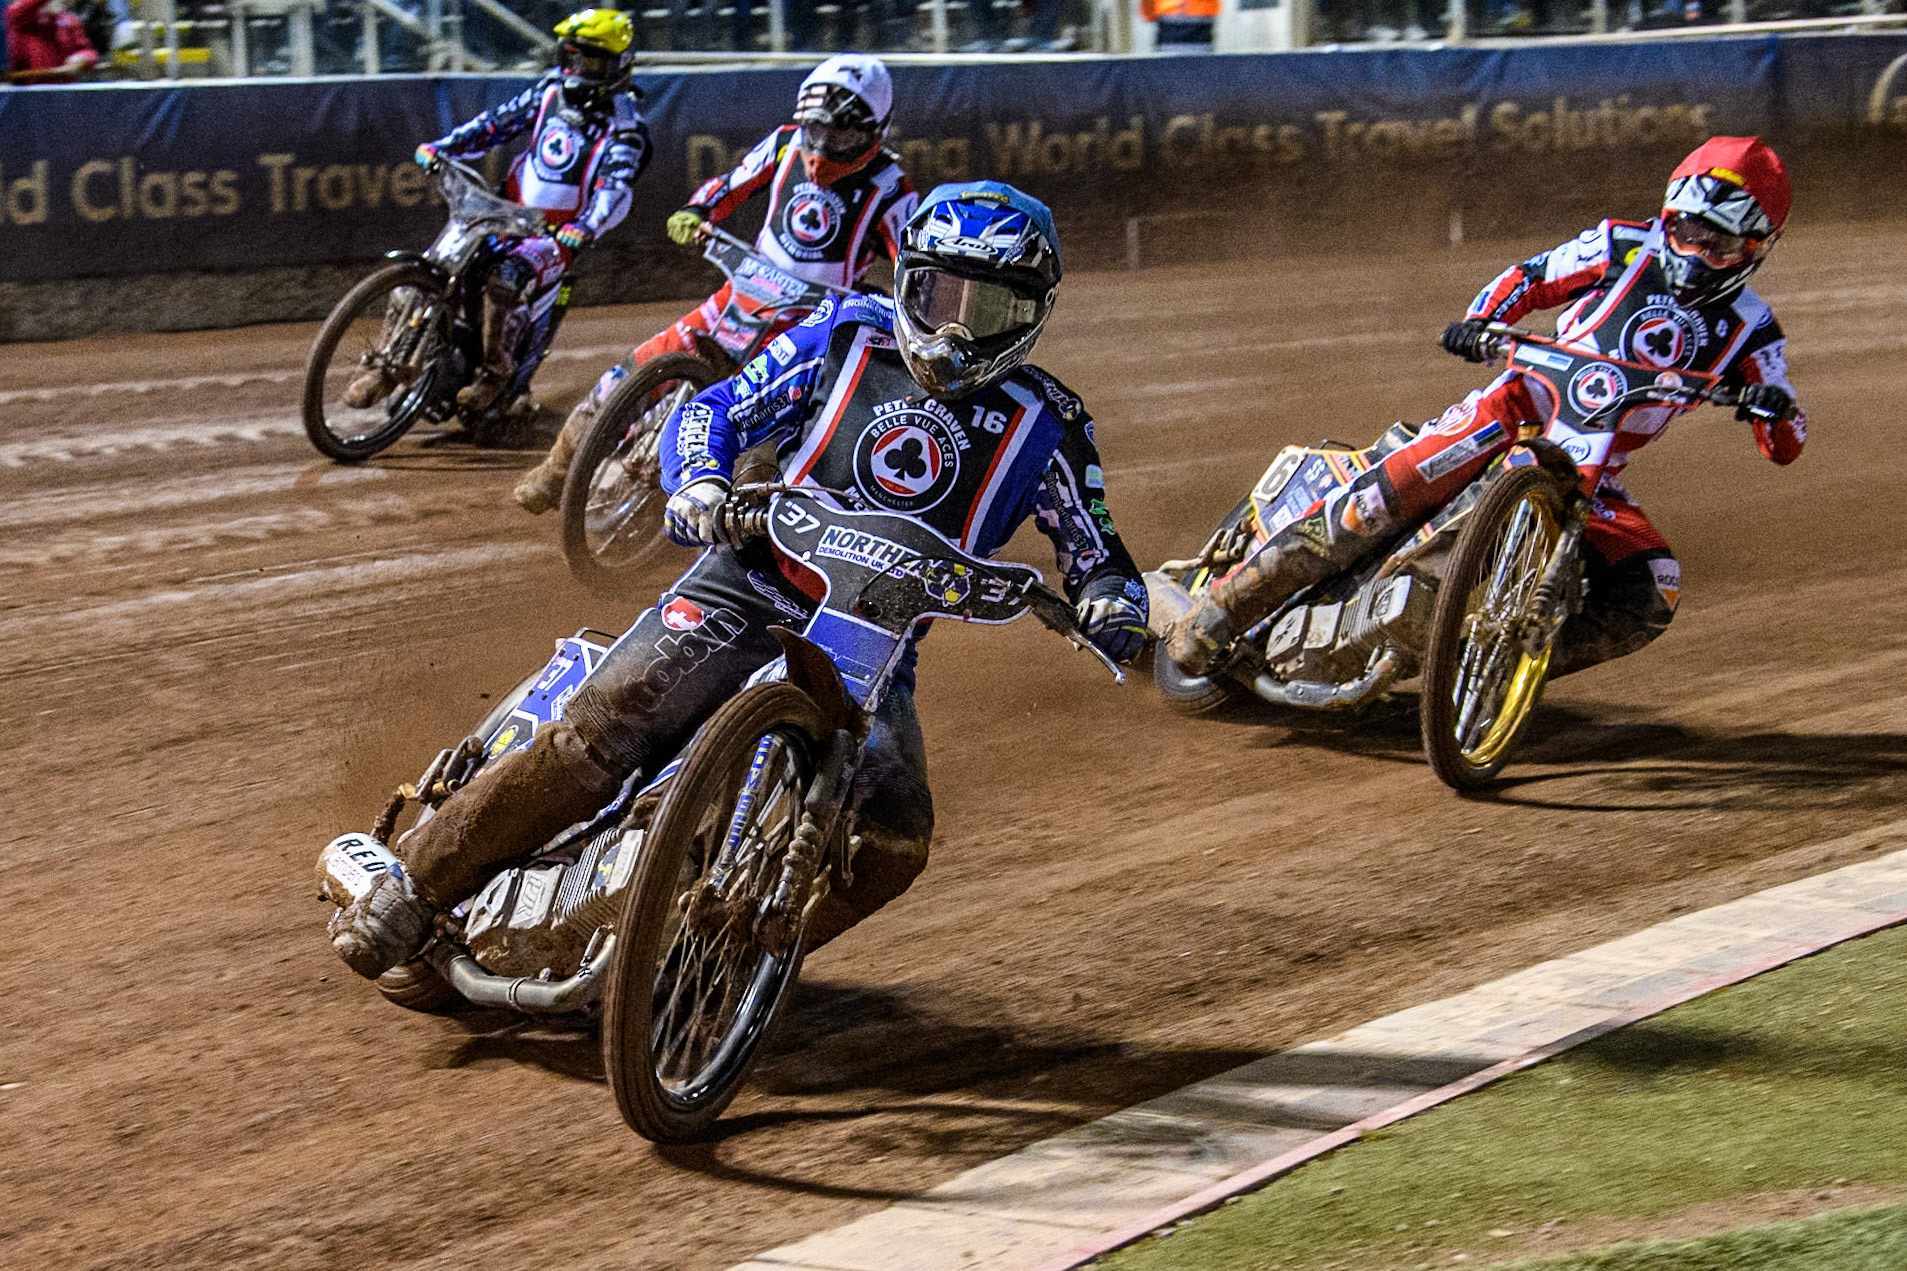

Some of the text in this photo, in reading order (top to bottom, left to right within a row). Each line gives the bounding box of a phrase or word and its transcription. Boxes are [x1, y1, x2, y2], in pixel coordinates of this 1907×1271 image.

[985, 115, 1144, 175] World
[1162, 111, 1301, 168] Class
[1316, 106, 1476, 162] Travel
[1490, 97, 1712, 152] Solutions
[71, 156, 241, 223] Class
[257, 153, 444, 213] Trave
[870, 414, 954, 468] BELLE VUE ACES
[923, 398, 972, 451] CRAVEN
[971, 405, 1008, 434] 16
[1261, 453, 1300, 495] 6
[818, 546, 869, 565] DEMOLITION
[870, 559, 885, 570] UK
